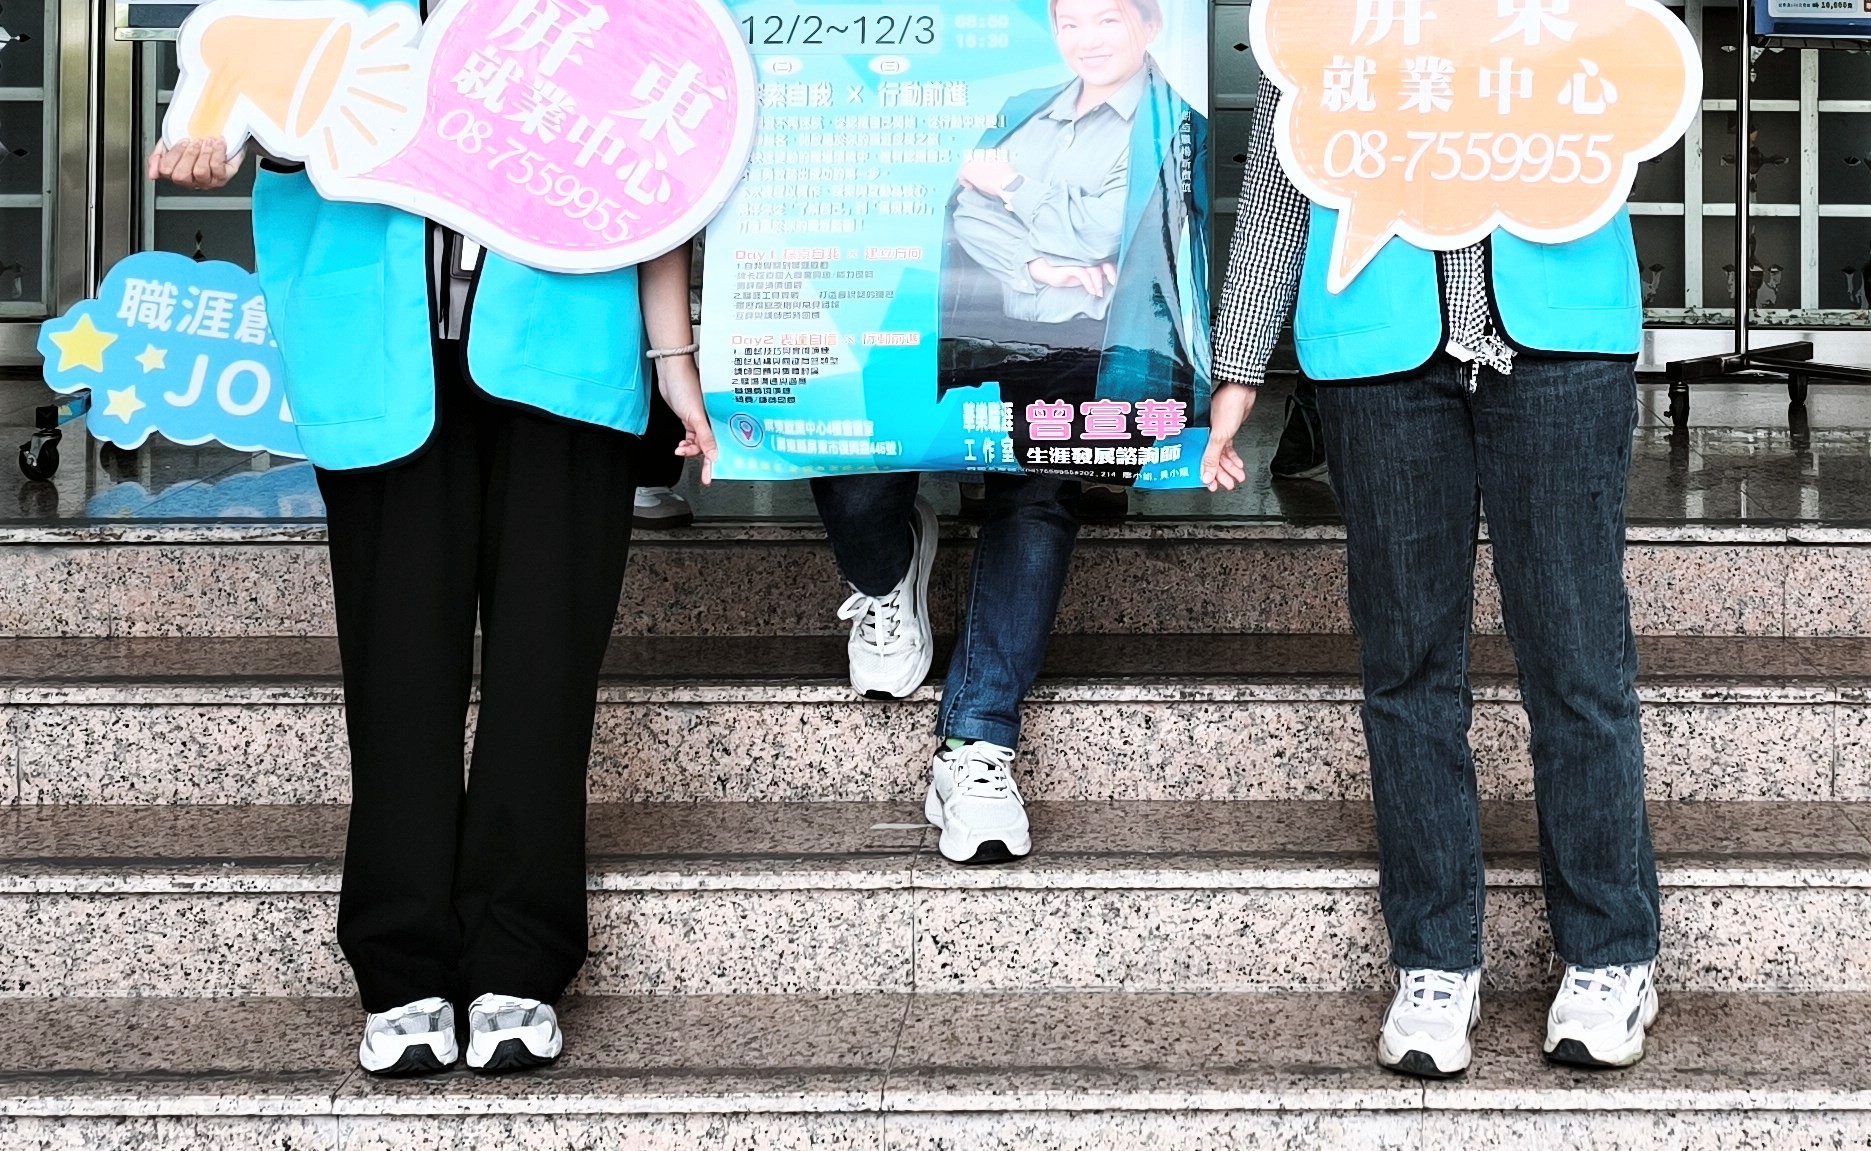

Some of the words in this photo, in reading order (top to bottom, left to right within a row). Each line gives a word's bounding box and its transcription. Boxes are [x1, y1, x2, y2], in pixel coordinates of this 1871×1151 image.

[741, 15, 935, 45] 12/2~12/3
[1320, 54, 1618, 116] 就業中心
[452, 45, 671, 206] 就業中心
[437, 109, 641, 243] 08-7559955
[1322, 129, 1616, 184] 08-7559955
[732, 335, 774, 345] Day2
[163, 354, 296, 424] JO
[1025, 398, 1188, 441] 曾宣華
[963, 435, 1015, 463] 工作室
